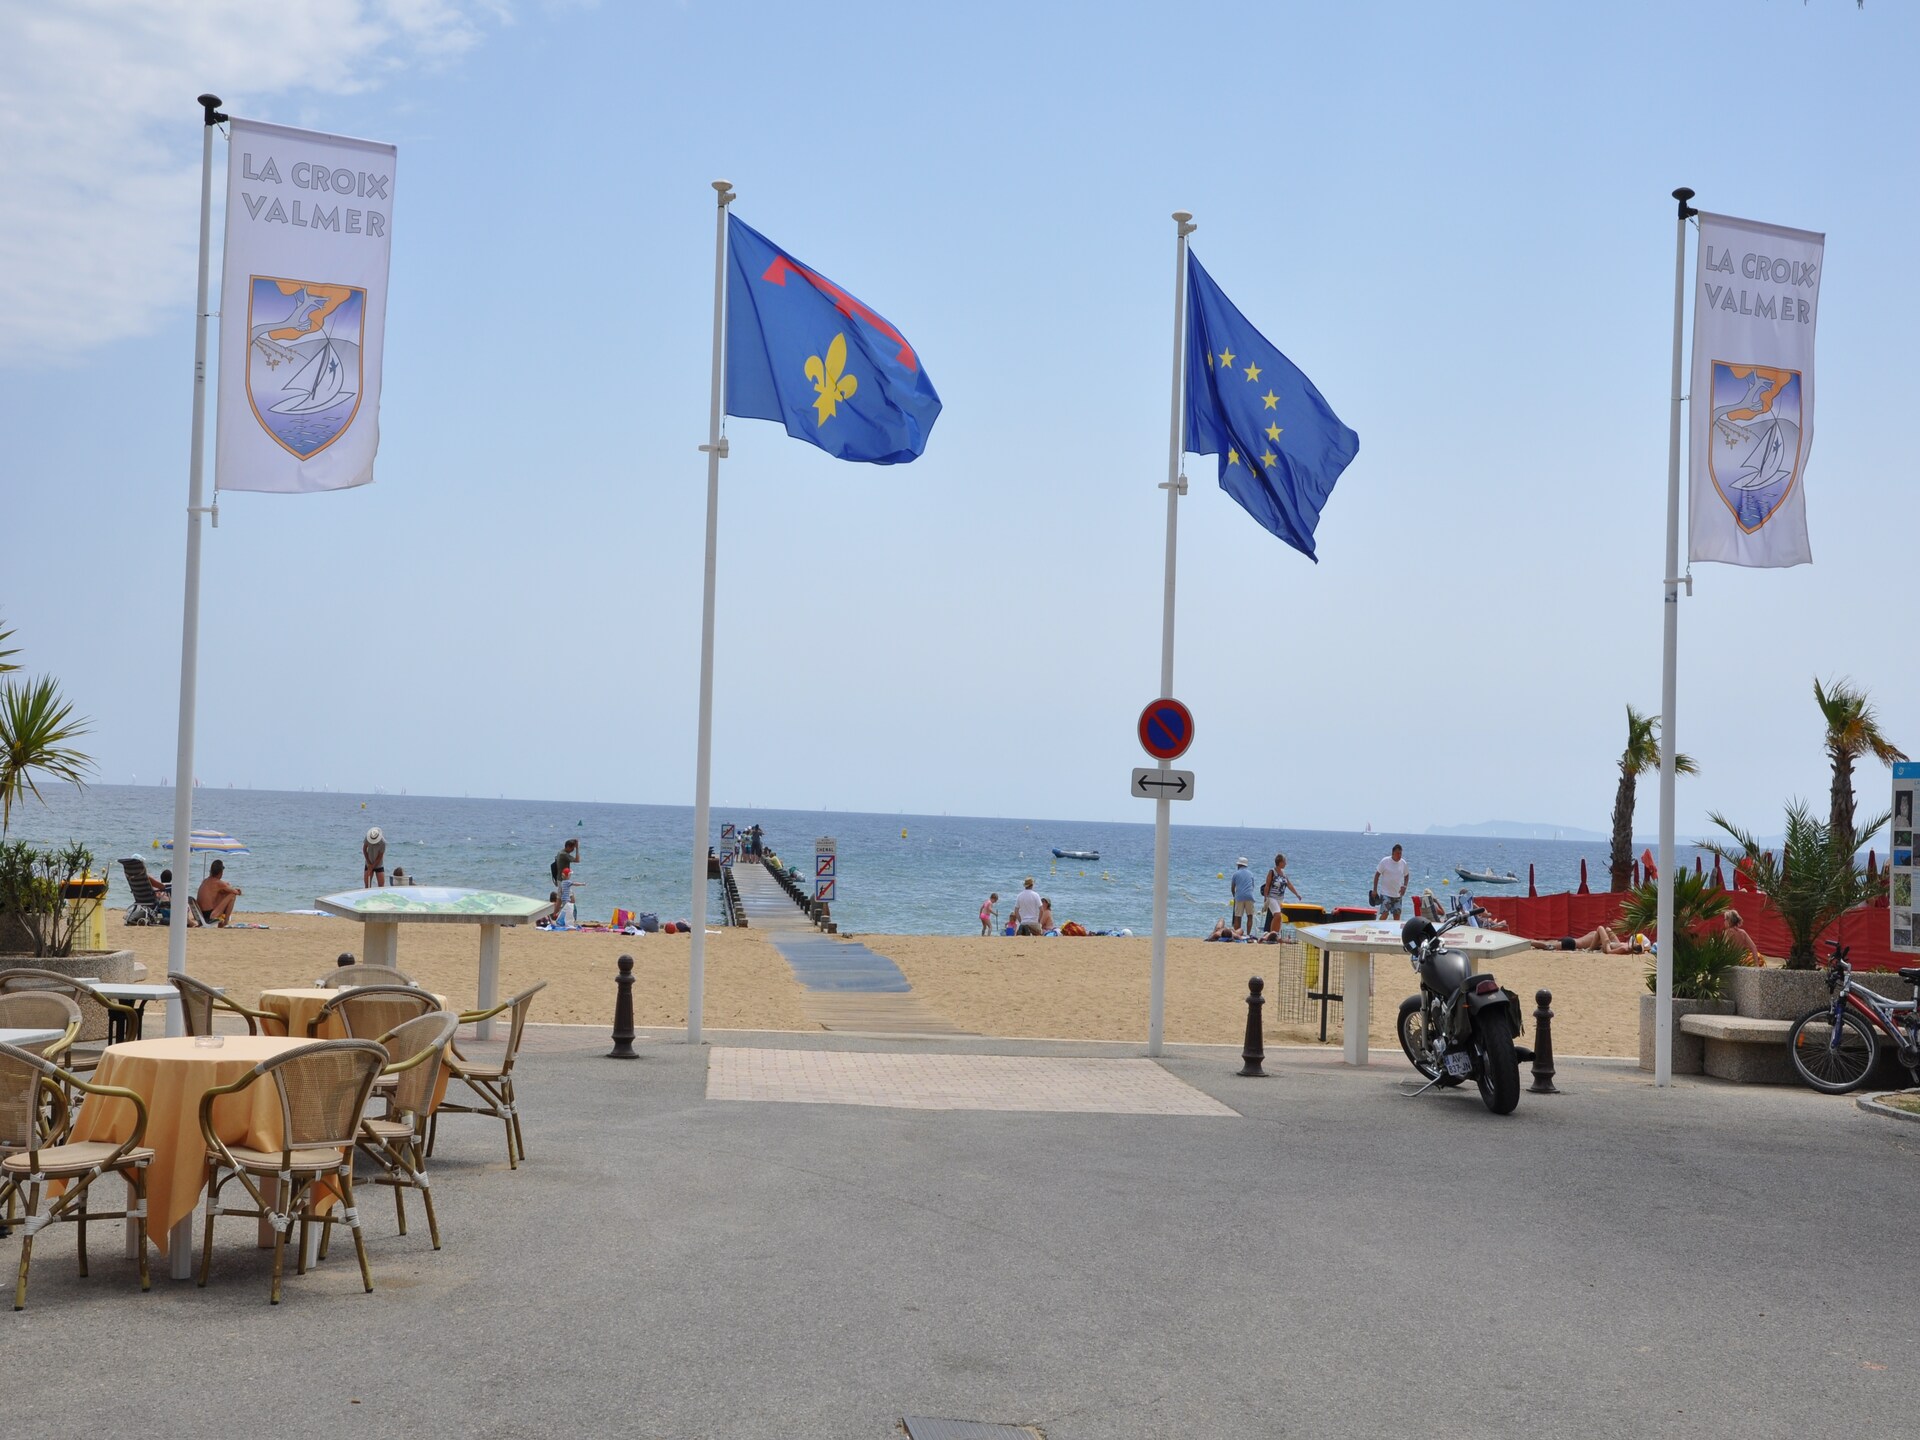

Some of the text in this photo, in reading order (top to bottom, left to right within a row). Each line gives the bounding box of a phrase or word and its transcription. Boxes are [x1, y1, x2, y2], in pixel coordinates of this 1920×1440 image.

[242, 153, 389, 200] LA CROIX
[242, 192, 386, 238] VALMER
[1705, 245, 1816, 288] LA CROIX
[1704, 283, 1811, 325] VALMER
